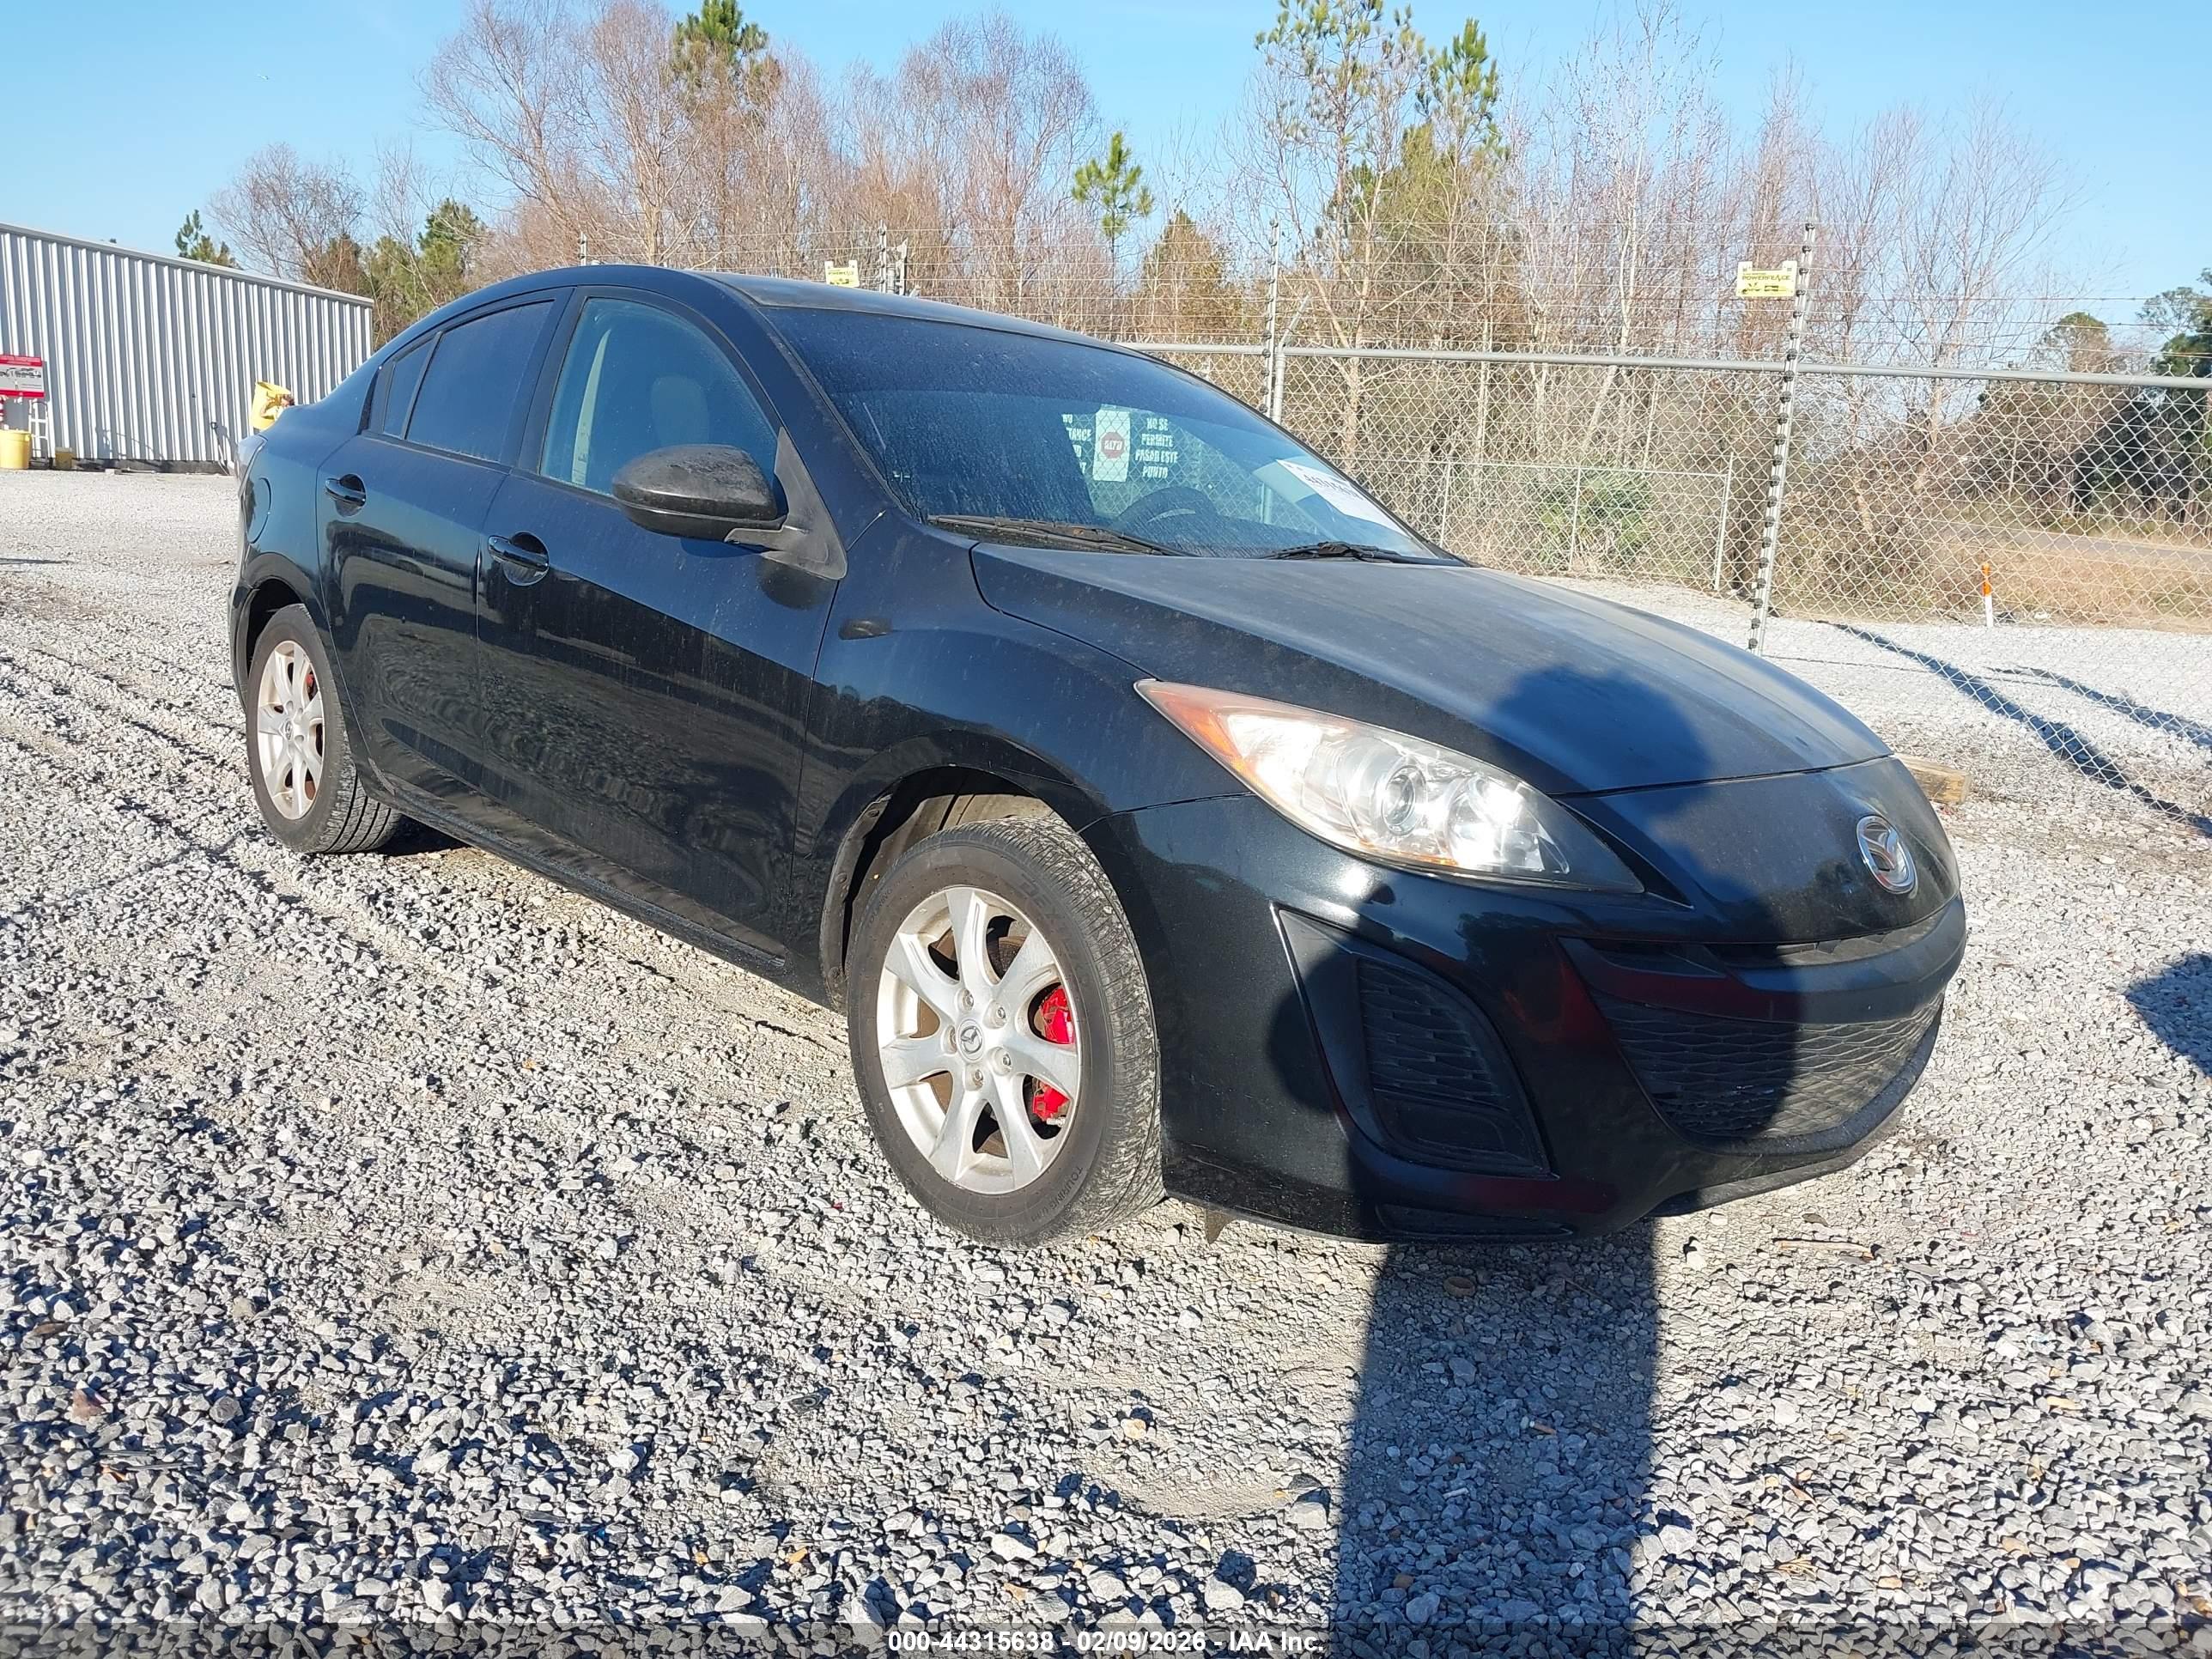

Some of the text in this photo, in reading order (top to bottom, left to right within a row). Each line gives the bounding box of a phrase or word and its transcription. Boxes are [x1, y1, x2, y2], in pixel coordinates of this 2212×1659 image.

[1146, 417, 1169, 431] NO SE
[1066, 427, 1092, 441] TANCE
[1141, 433, 1174, 447] PERMITE
[1103, 440, 1123, 451] ALTO
[1134, 449, 1179, 464] PASAR ESTE
[1142, 465, 1169, 479] PUNTO
[1049, 1166, 1084, 1210] TOURING
